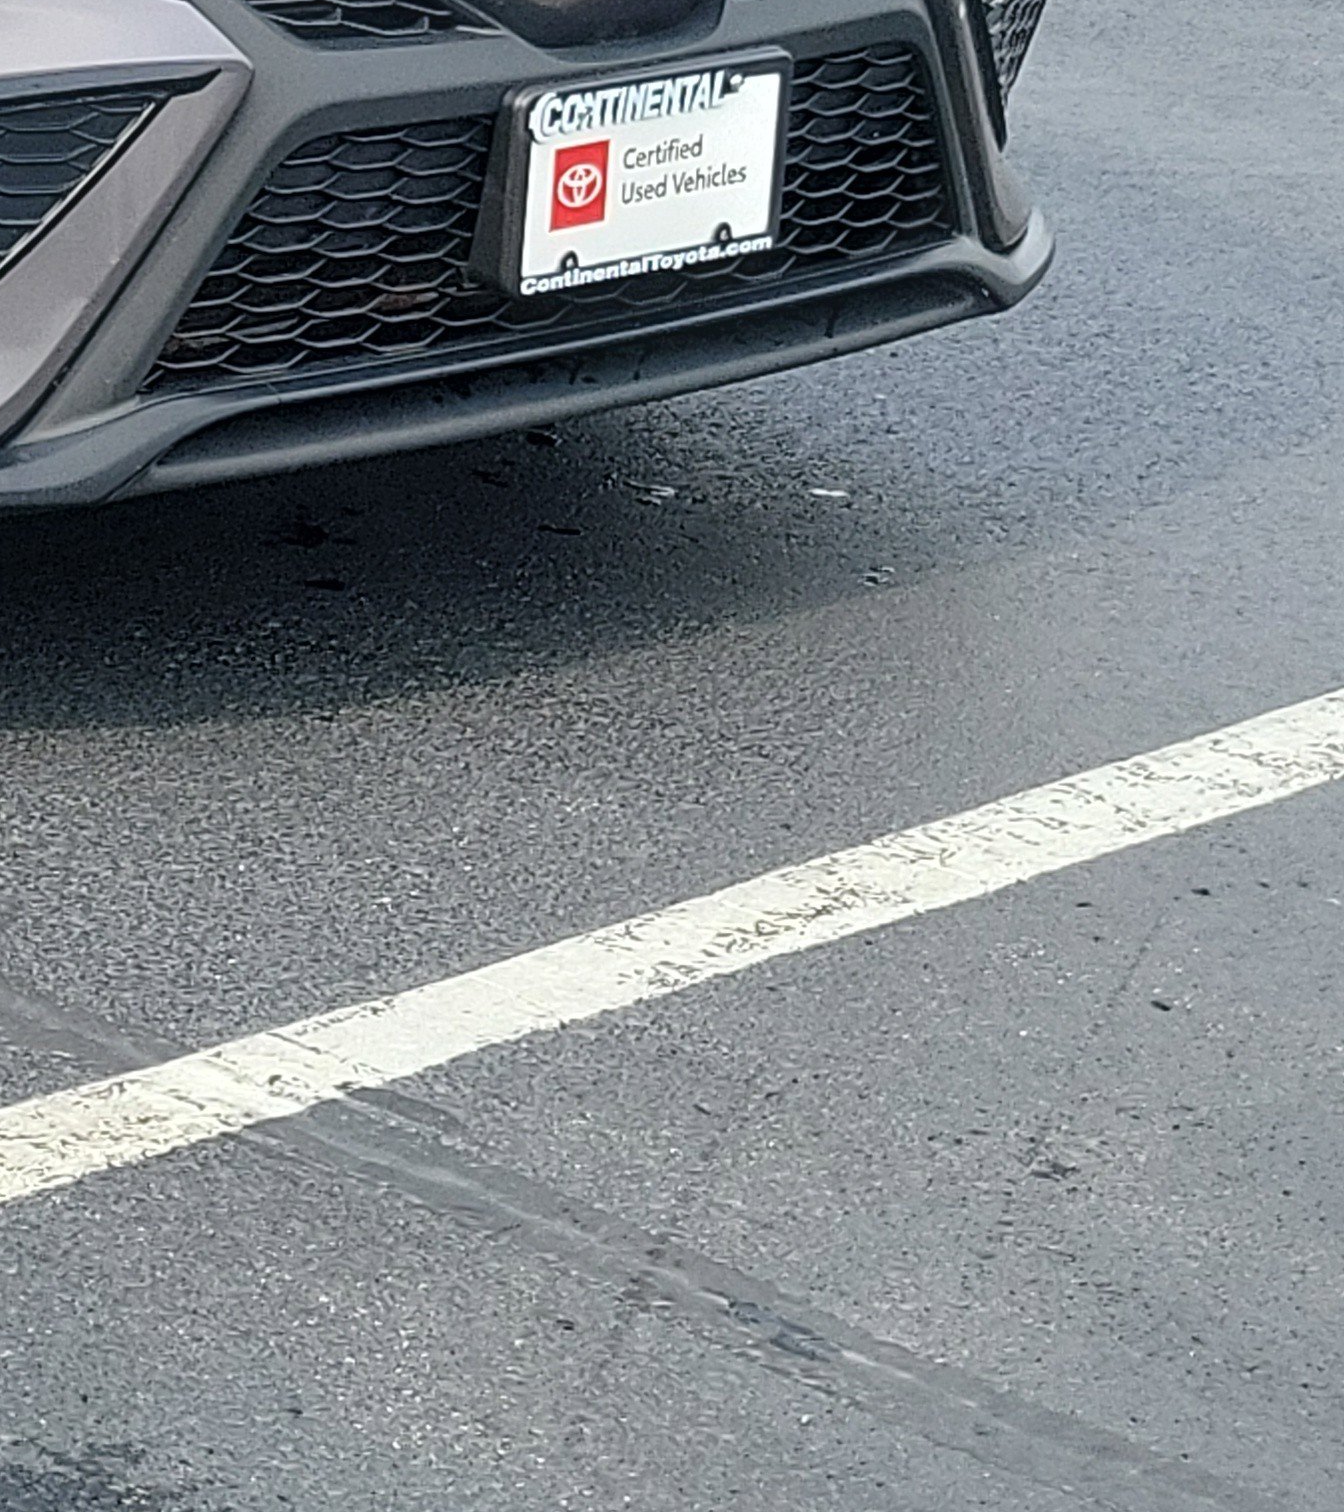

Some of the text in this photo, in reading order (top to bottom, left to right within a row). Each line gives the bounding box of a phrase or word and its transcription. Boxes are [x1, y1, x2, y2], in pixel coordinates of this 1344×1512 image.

[541, 70, 726, 136] CONTINENTAL
[623, 134, 703, 169] Certified
[621, 163, 748, 205] Used Vehicles
[520, 236, 773, 296] ContinentalToyota.com
